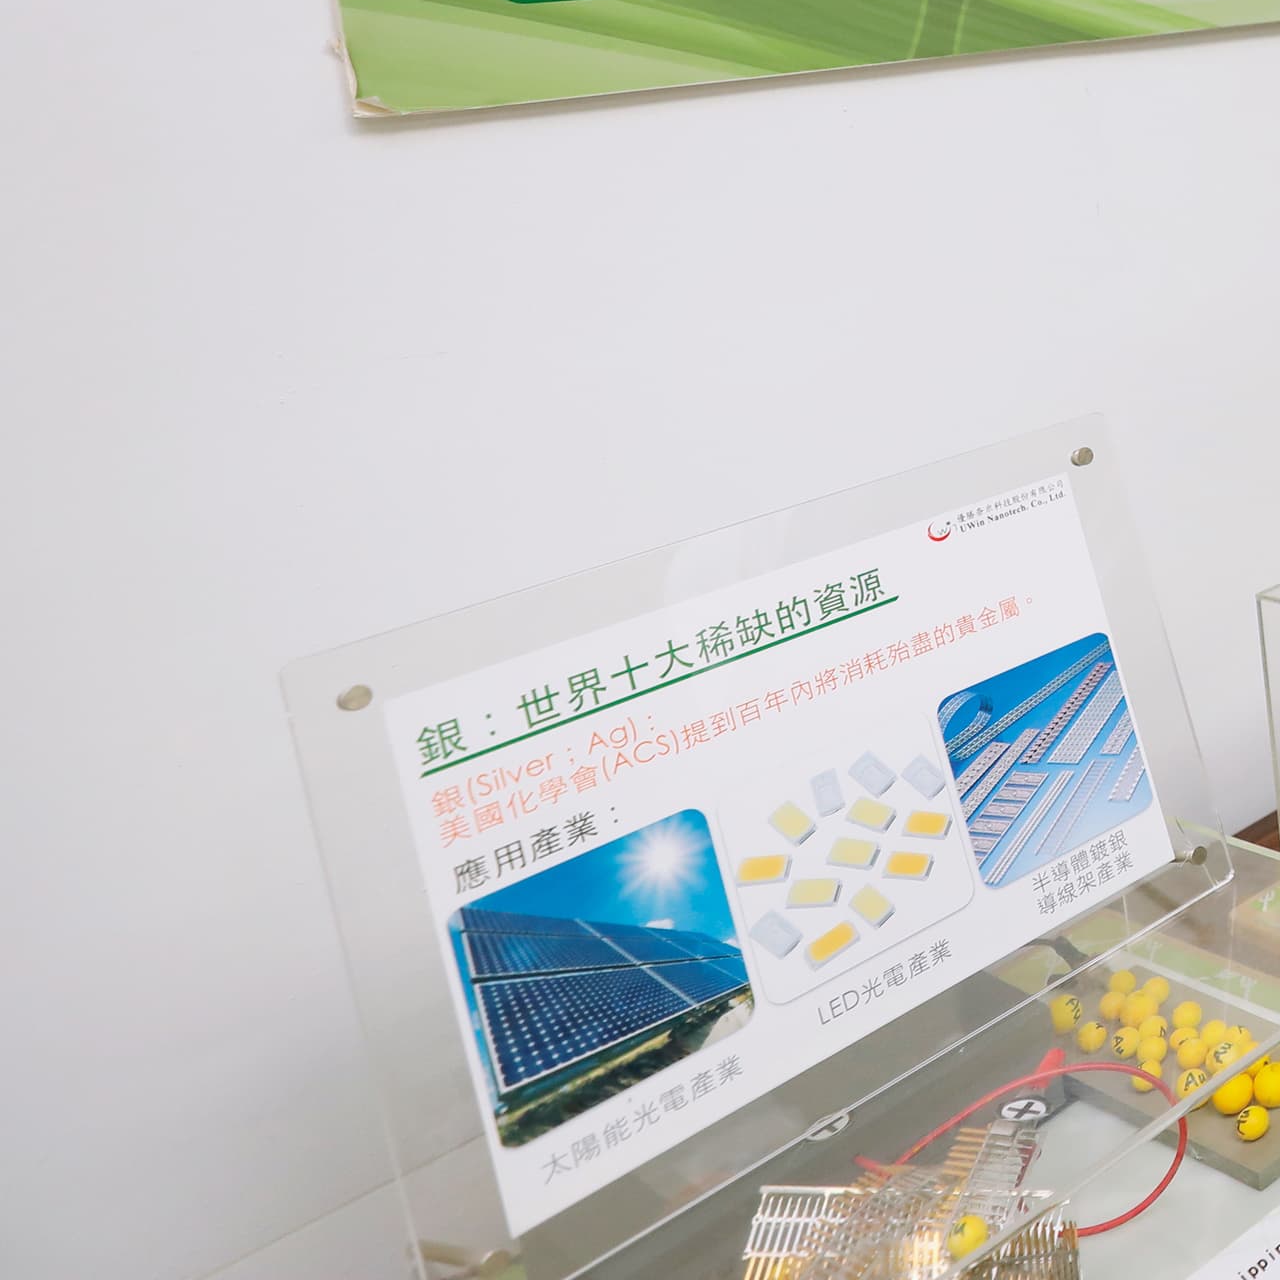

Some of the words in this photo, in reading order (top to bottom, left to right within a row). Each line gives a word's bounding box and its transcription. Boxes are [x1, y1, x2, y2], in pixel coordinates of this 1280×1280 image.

[542, 1054, 745, 1184] 太陽能光電產業
